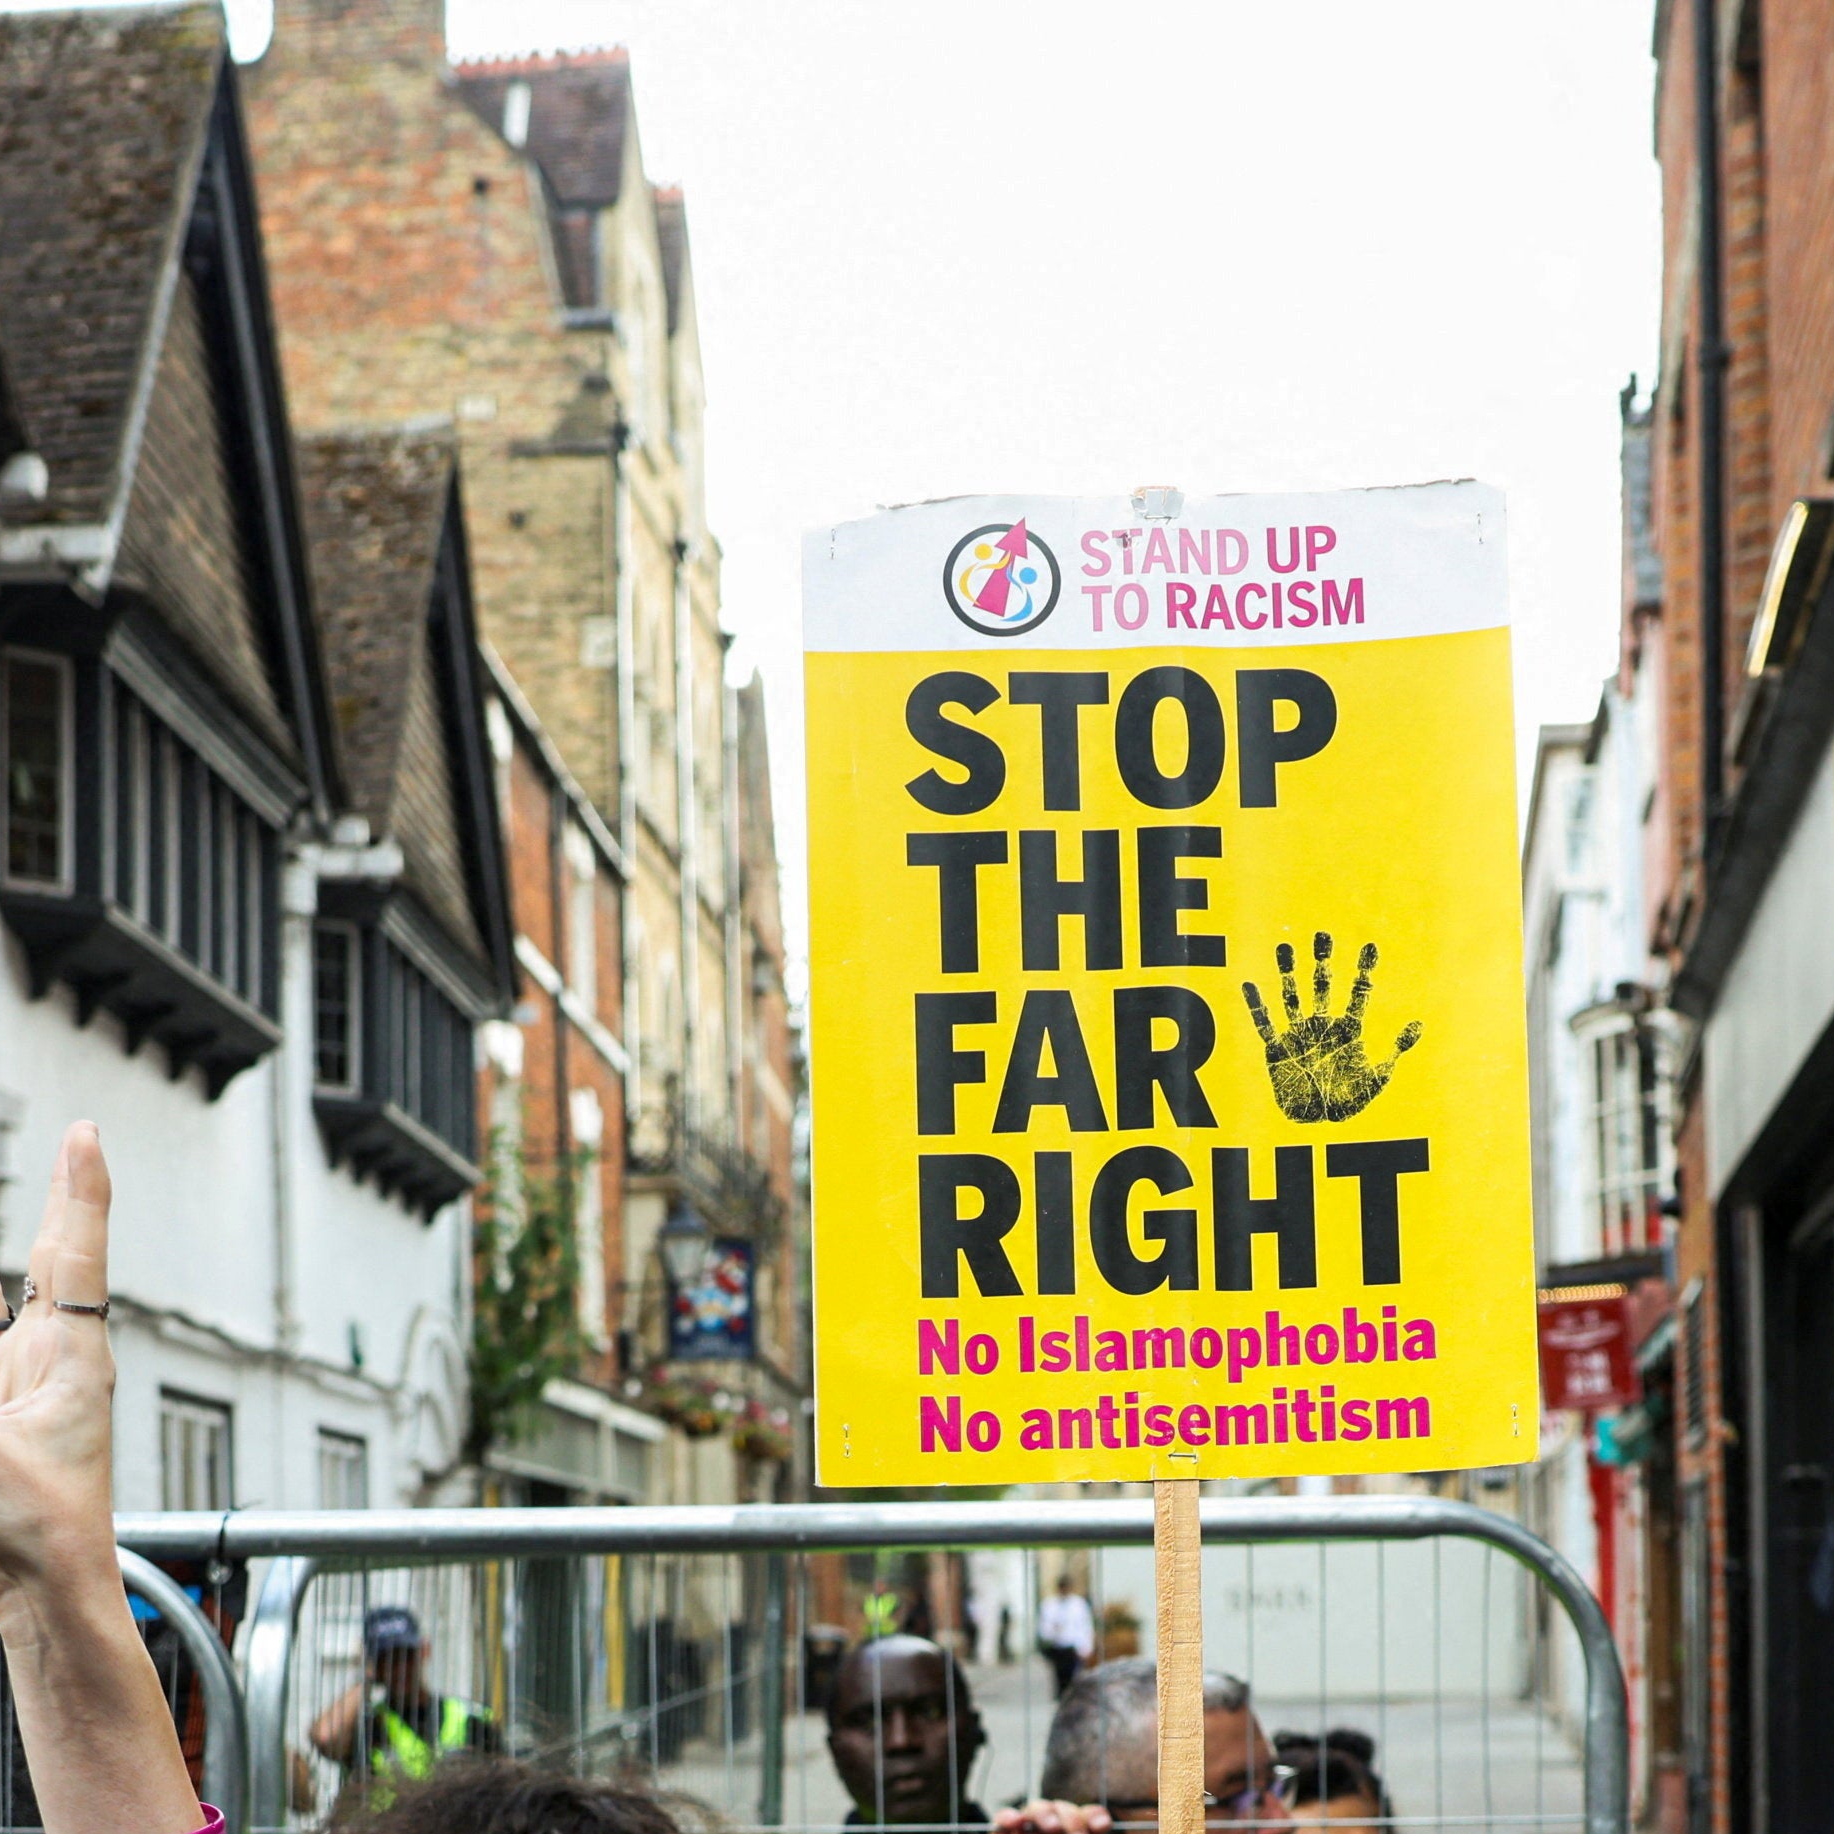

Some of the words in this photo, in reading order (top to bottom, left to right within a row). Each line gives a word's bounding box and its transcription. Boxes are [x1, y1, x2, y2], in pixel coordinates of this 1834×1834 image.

[1079, 525, 1249, 577] STAND
[1267, 524, 1338, 574] UP
[1081, 583, 1151, 633] TO
[1166, 577, 1367, 631] RACISM
[903, 665, 1338, 816] STOP
[905, 825, 1227, 974] THE
[914, 985, 1220, 1136] FAR
[918, 1137, 1430, 1299] RIGHT
[918, 1318, 1000, 1376] No
[1018, 1305, 1438, 1384] Islamophobia
[920, 1395, 1002, 1454] No
[1020, 1384, 1432, 1451] antisemitism
